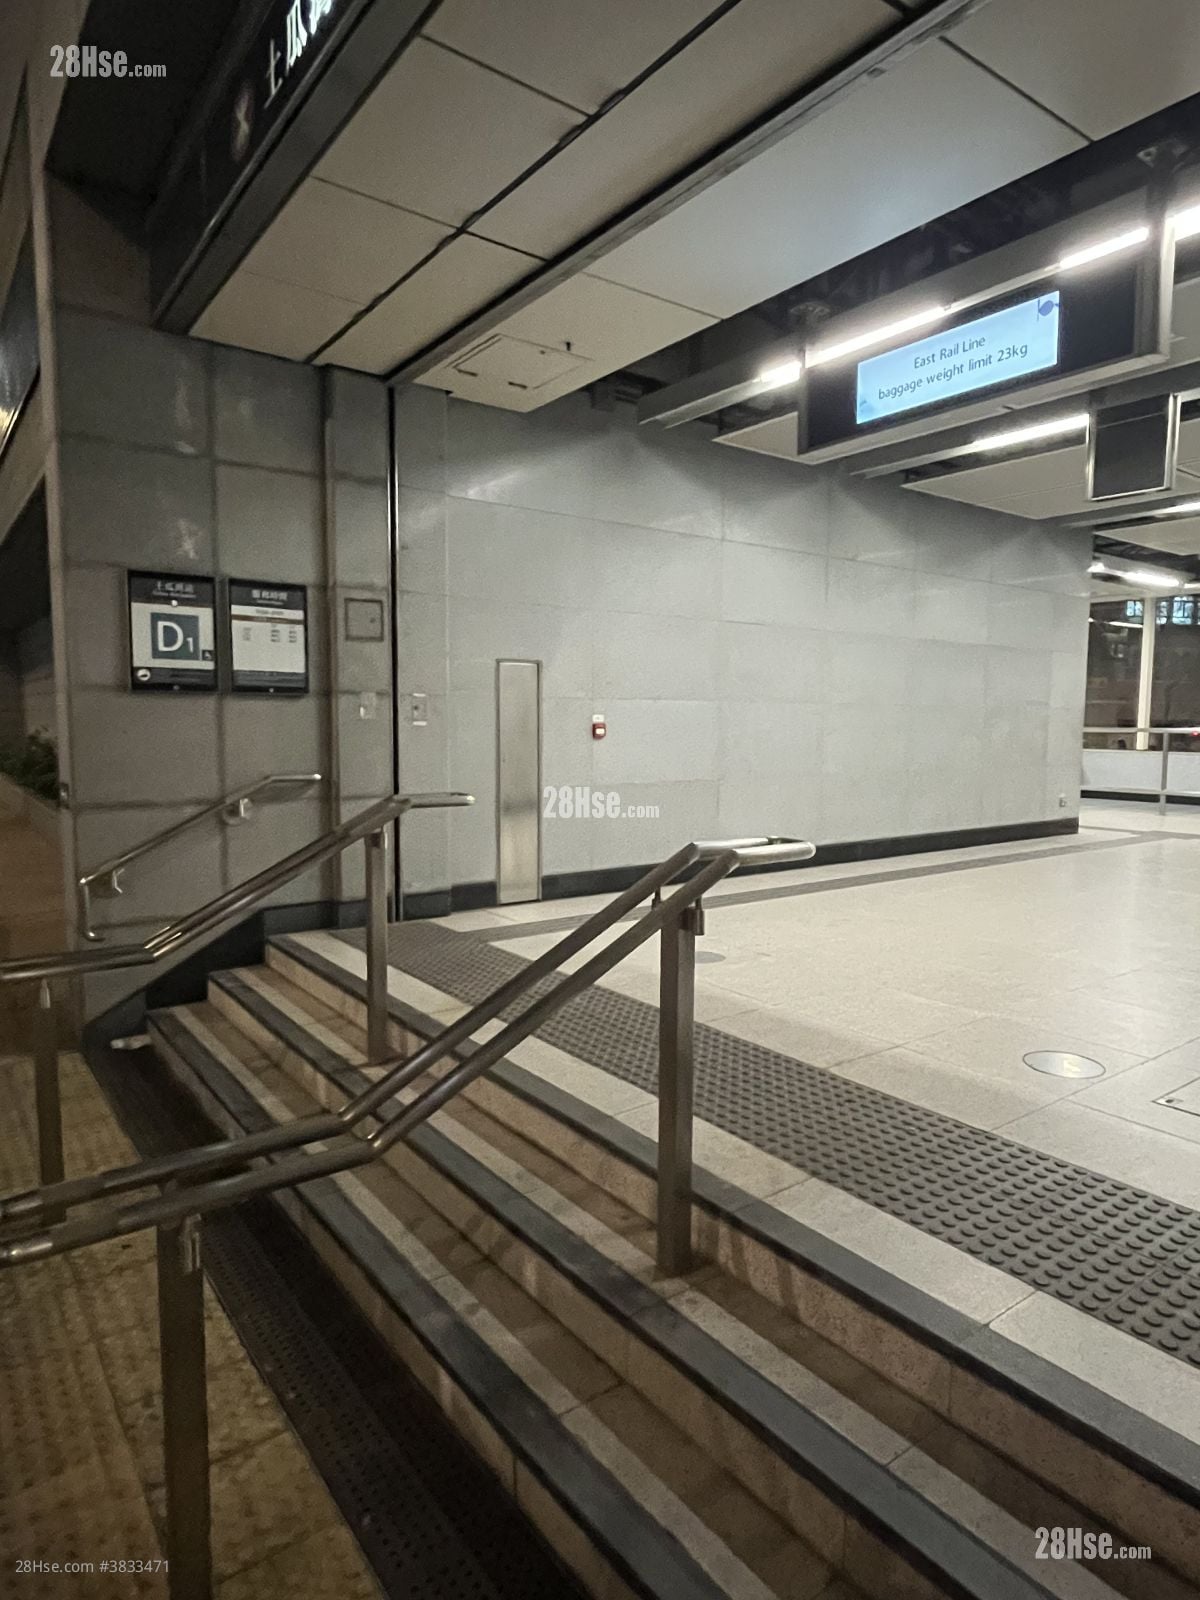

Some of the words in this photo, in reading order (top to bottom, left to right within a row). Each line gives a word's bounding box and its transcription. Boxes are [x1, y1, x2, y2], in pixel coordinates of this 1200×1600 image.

[878, 377, 923, 400] baggage
[926, 363, 964, 385] weight
[968, 354, 993, 372] limit
[997, 343, 1029, 363] 23kg
[913, 353, 936, 369] East
[939, 343, 959, 361] Rail
[962, 336, 986, 353] Line
